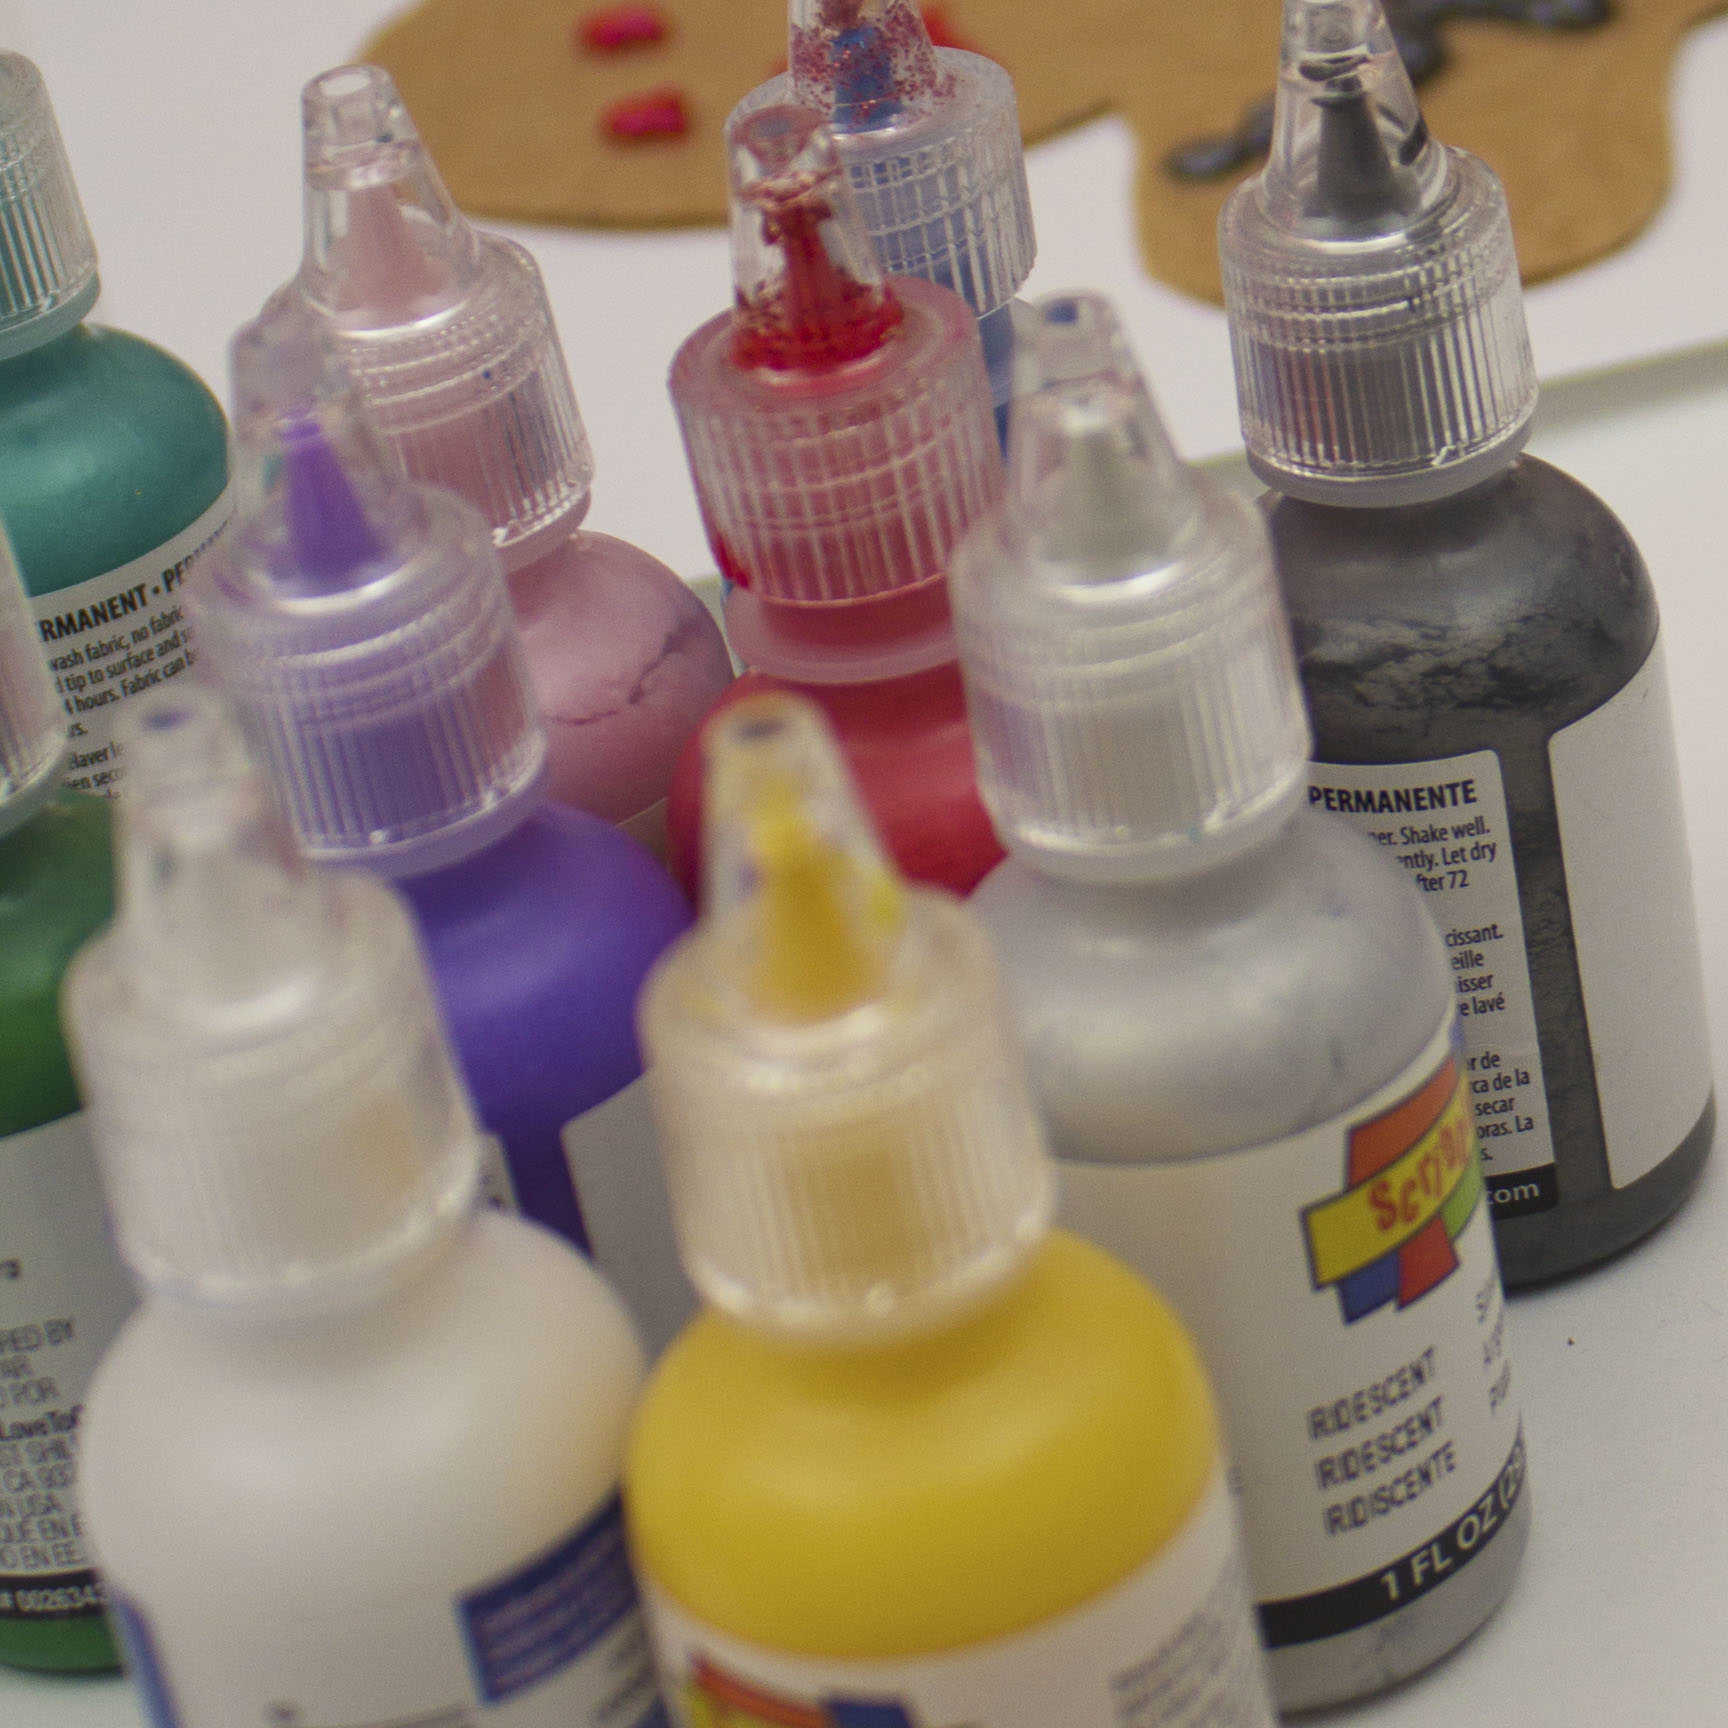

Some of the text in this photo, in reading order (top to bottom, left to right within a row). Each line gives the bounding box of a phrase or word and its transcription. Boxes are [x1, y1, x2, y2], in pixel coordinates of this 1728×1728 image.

[131, 624, 148, 642] no
[65, 670, 86, 694] tip
[88, 665, 104, 685] to
[107, 646, 154, 675] surface
[155, 629, 180, 658] and
[120, 668, 162, 698] Fabric
[162, 656, 185, 678] can
[1308, 779, 1477, 813] PERMANENTE
[1400, 824, 1448, 845] Shake
[1451, 816, 1490, 840] well.
[1442, 846, 1466, 865] Let
[1470, 841, 1496, 863] dry
[1449, 869, 1469, 889] 72
[1472, 991, 1504, 1014] lavé
[1480, 1052, 1500, 1070] de
[1493, 1073, 1511, 1090] de
[1516, 1069, 1530, 1086] la
[1475, 1096, 1515, 1116] secar
[1516, 1115, 1533, 1134] La
[1380, 1571, 1399, 1601] 1
[1411, 1543, 1453, 1587] FL
[1456, 1496, 1498, 1549] OZ
